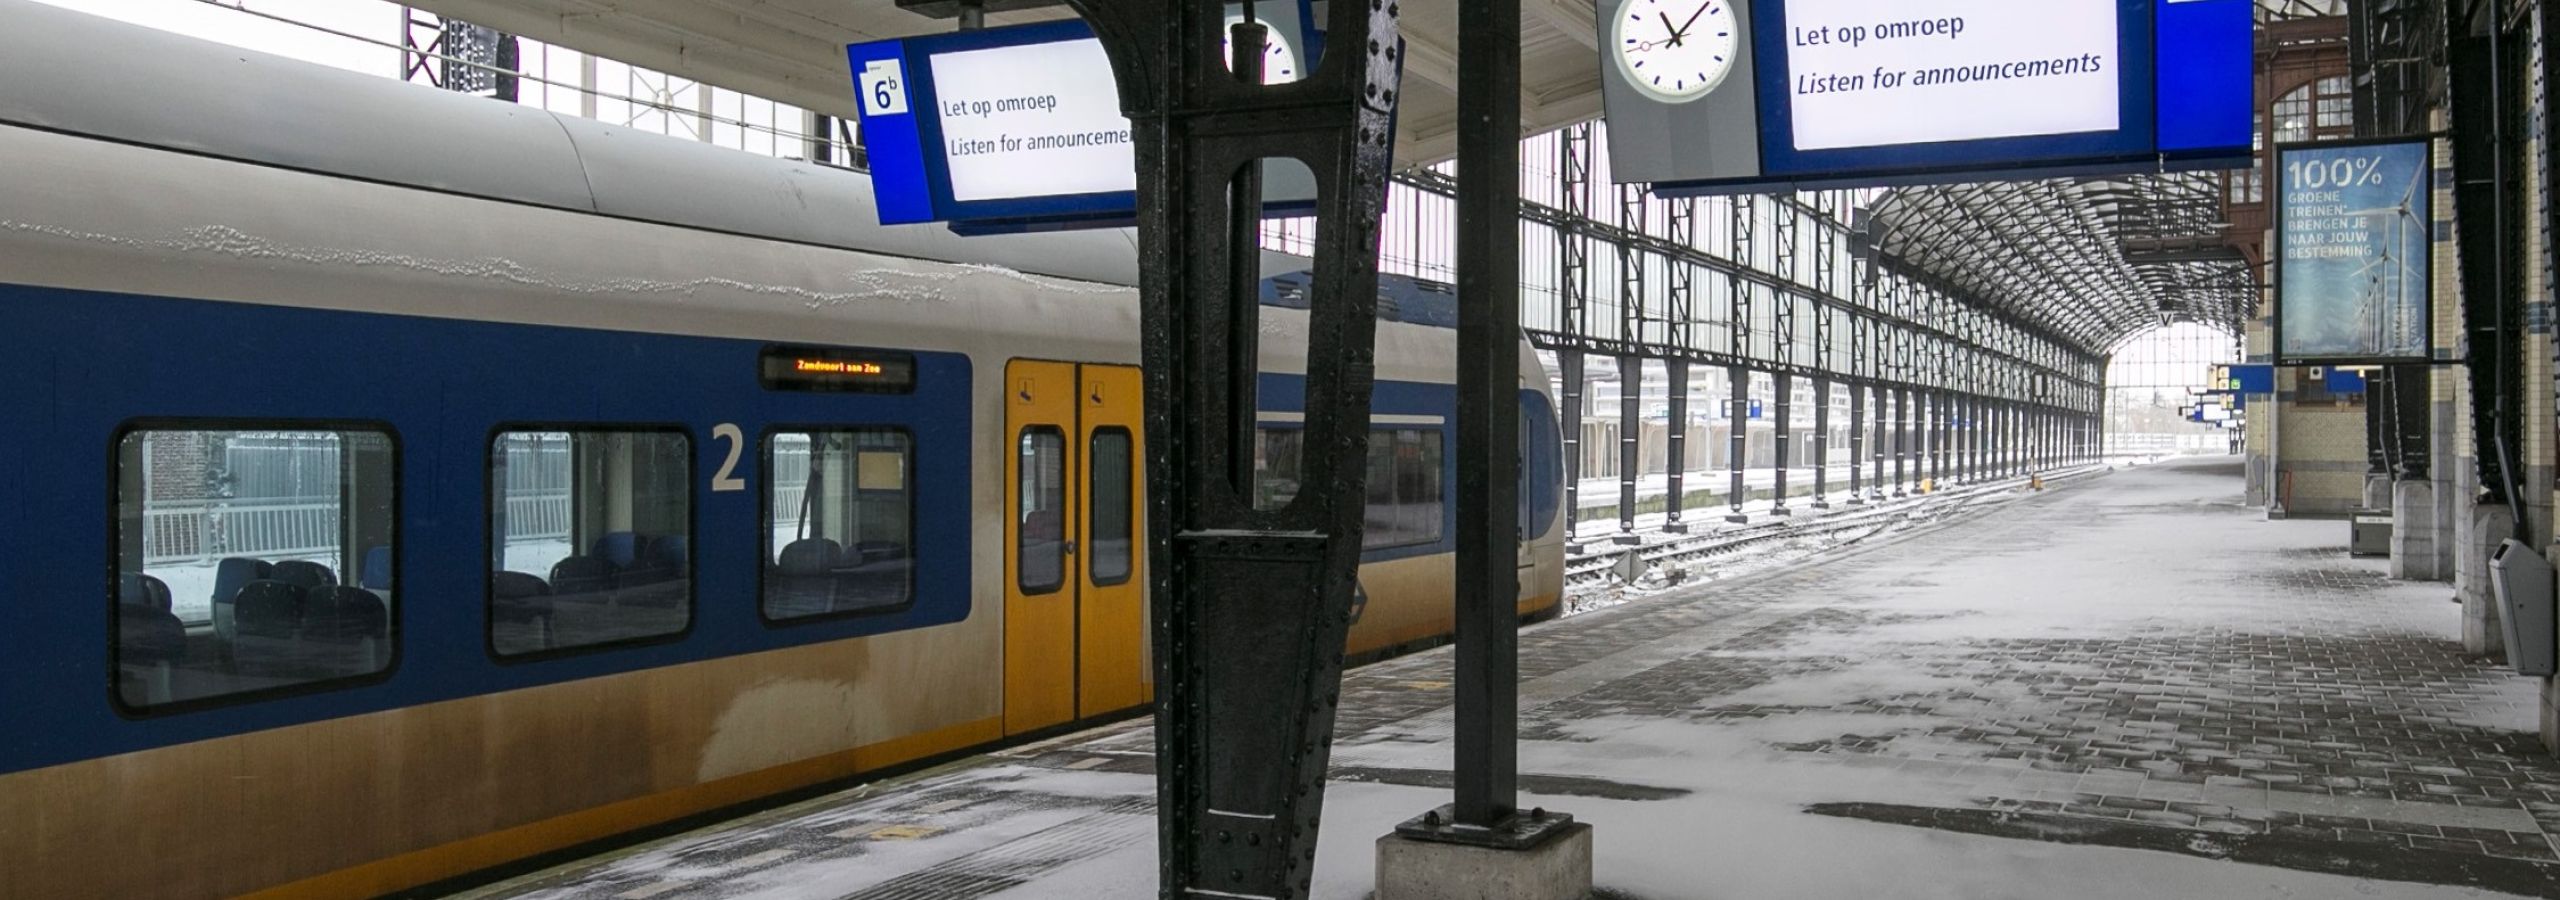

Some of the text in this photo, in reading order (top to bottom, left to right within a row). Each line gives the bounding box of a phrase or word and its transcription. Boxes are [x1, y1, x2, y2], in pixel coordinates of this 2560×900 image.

[1796, 17, 1964, 47] Let op omroep
[1798, 52, 2101, 95] Listen for announcements
[943, 94, 1057, 118] Let op omroep
[951, 138, 995, 156] Listen
[1000, 134, 1023, 152] for
[2288, 156, 2382, 189] 100%
[2288, 190, 2340, 203] GROENE
[2288, 216, 2368, 232] BRENGEN JE
[2288, 231, 2369, 246] NAAR JOUW
[2288, 244, 2372, 259] BESTEMMING
[797, 360, 881, 373] Zandvoort aan Zee
[711, 422, 746, 492] 2
